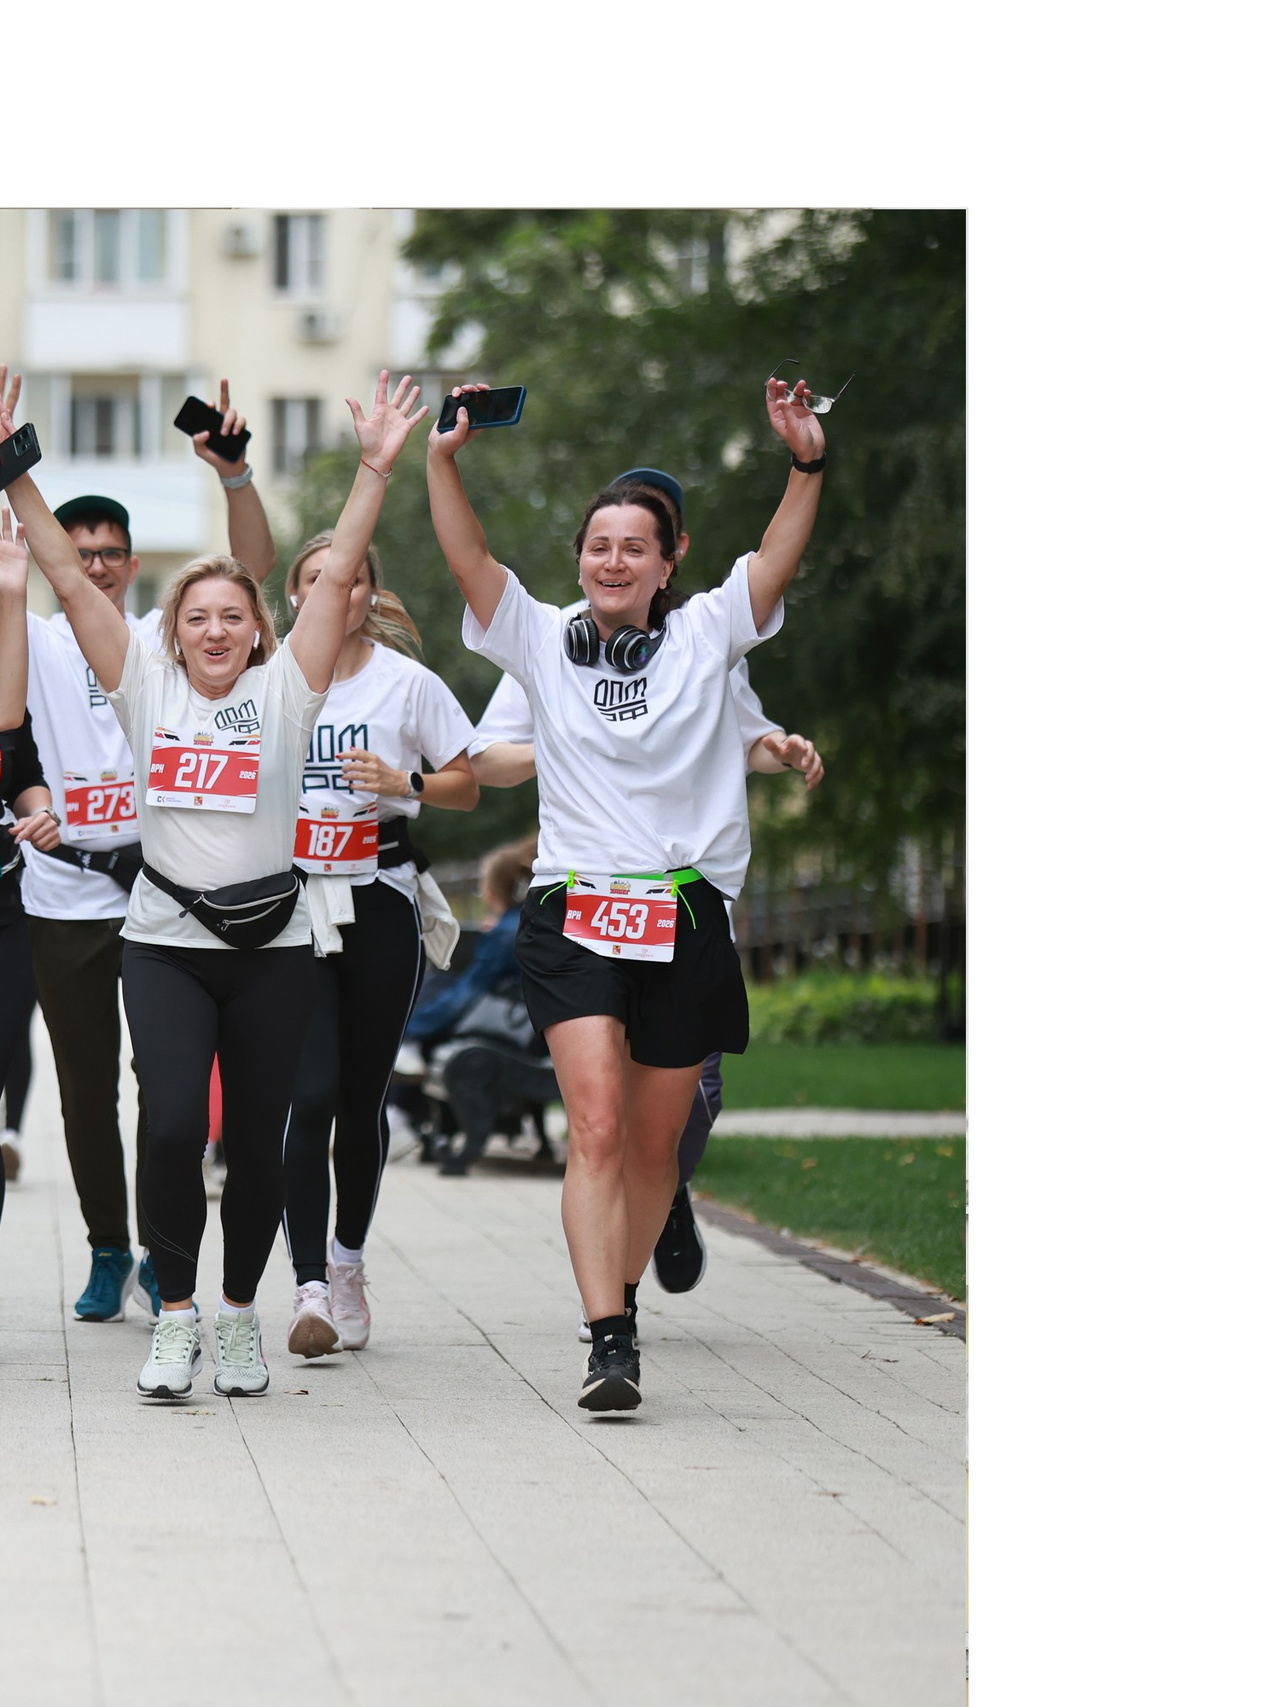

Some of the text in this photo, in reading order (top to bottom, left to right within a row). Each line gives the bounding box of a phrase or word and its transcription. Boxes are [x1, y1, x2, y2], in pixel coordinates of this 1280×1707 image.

[174, 752, 229, 790] 217
[239, 770, 257, 780] 2026
[87, 786, 136, 822] 273
[308, 823, 354, 858] 187
[590, 901, 649, 940] 453
[656, 919, 675, 929] 2026
